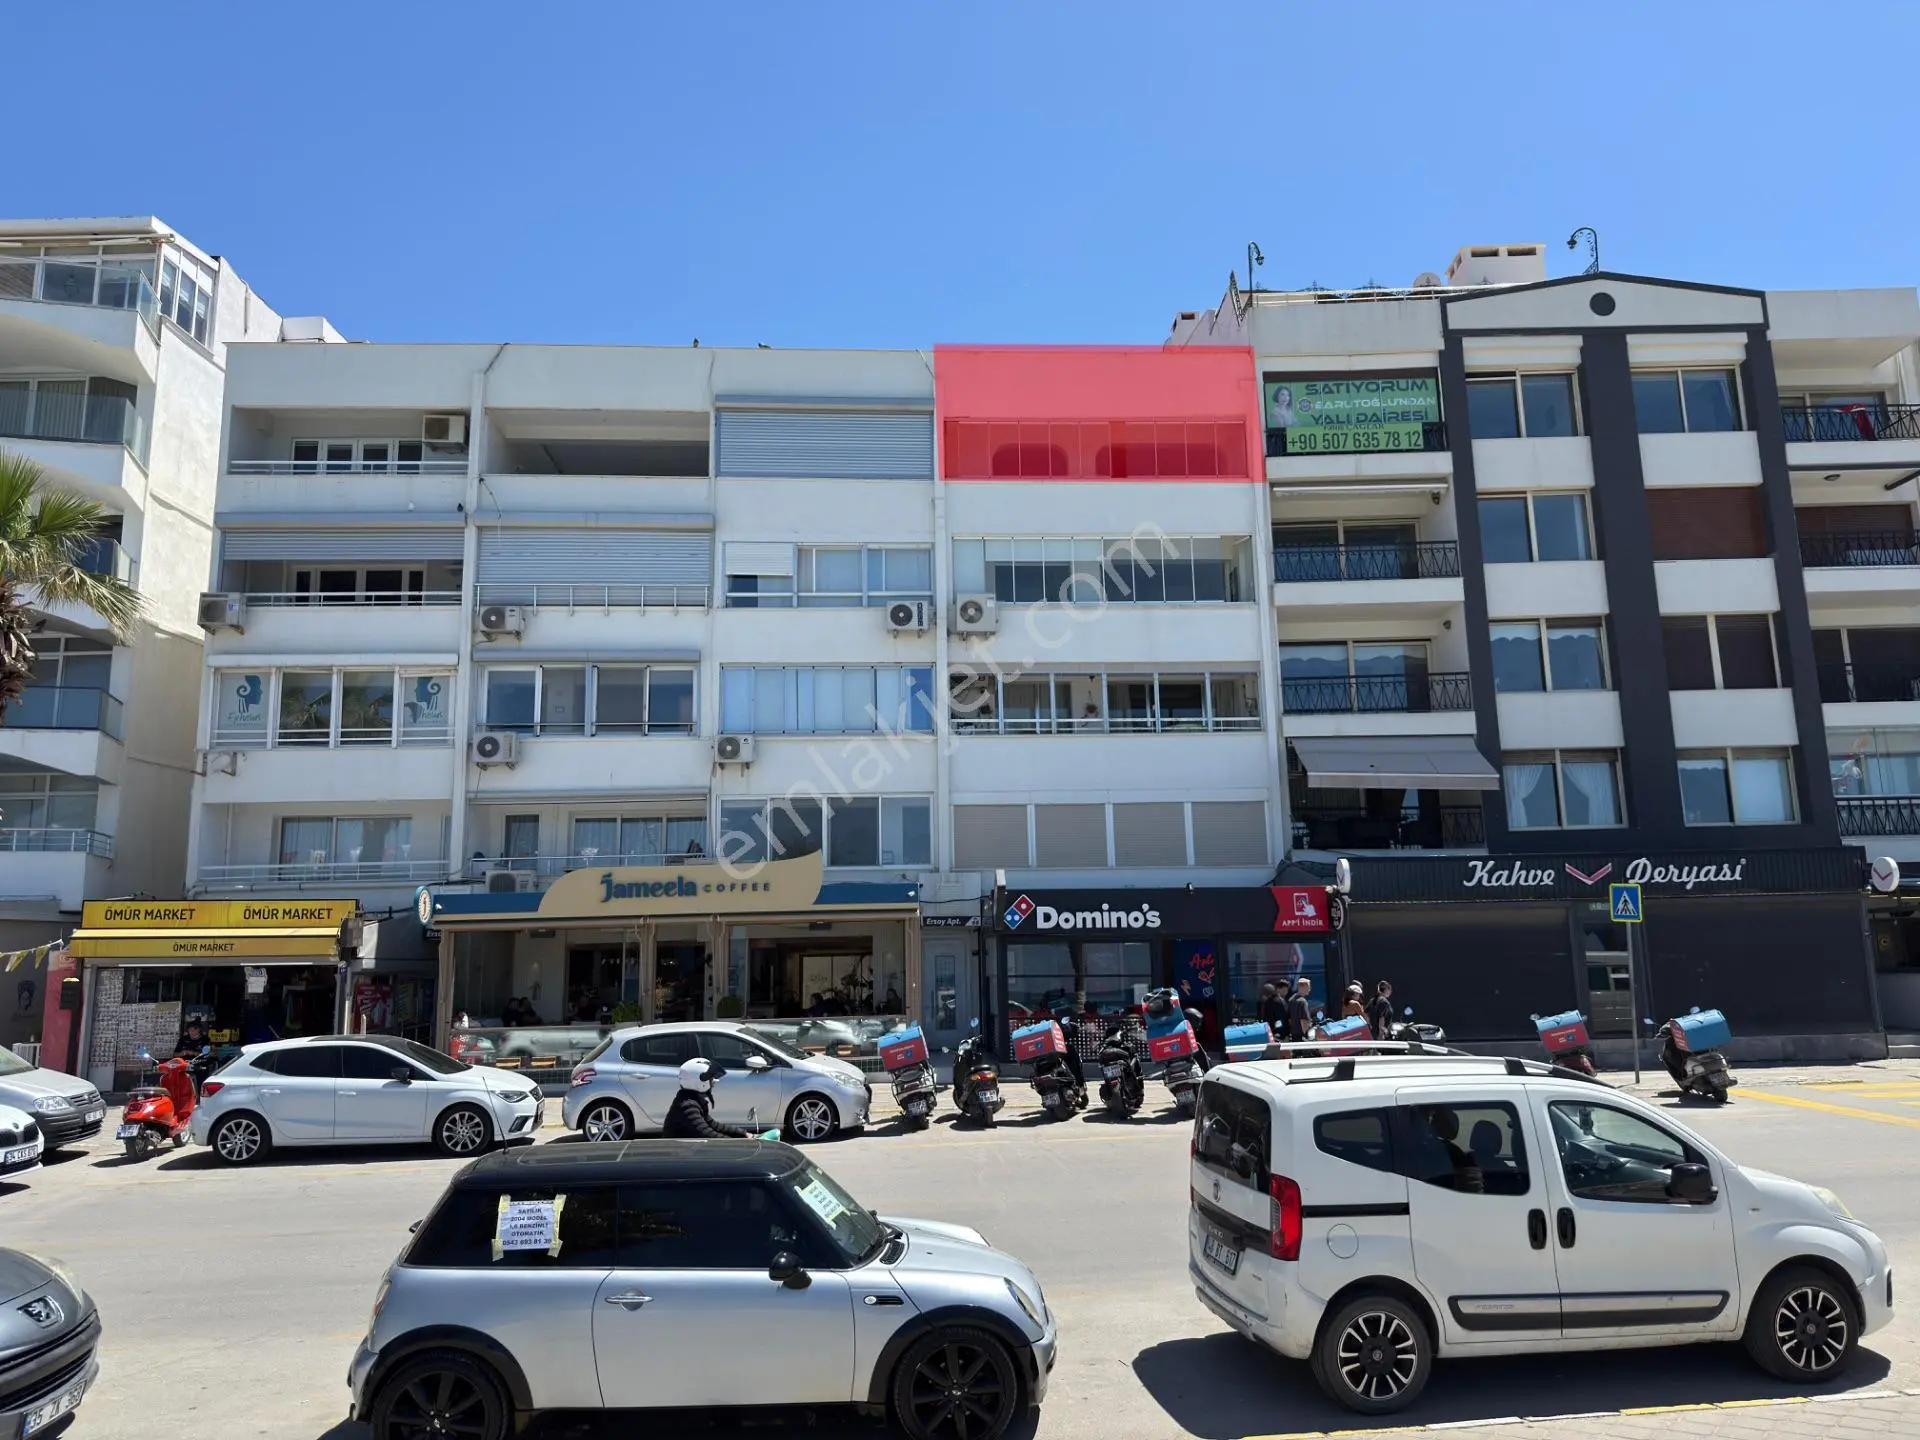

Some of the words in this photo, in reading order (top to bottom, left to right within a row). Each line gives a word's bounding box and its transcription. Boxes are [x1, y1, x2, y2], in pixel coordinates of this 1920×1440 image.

[1304, 379, 1430, 396] SATIYORUM
[1356, 408, 1429, 424] DAİRESİ
[1288, 433, 1317, 450] +90
[1322, 432, 1349, 449] 507
[1352, 431, 1380, 449] 635
[1383, 431, 1401, 448] 78
[1404, 430, 1422, 447] 12
[1463, 860, 1555, 887] Kahve
[600, 872, 698, 903] jameela
[702, 882, 771, 893] COFFEE
[104, 908, 141, 921] ÖMÜR
[143, 908, 196, 921] MARKET
[243, 907, 279, 920] ÖMÜR
[281, 908, 334, 920] MARKET
[1036, 902, 1162, 930] Domino's
[947, 918, 961, 926] Apt.
[172, 942, 198, 952] ÖMÜR
[199, 942, 235, 952] MARKET
